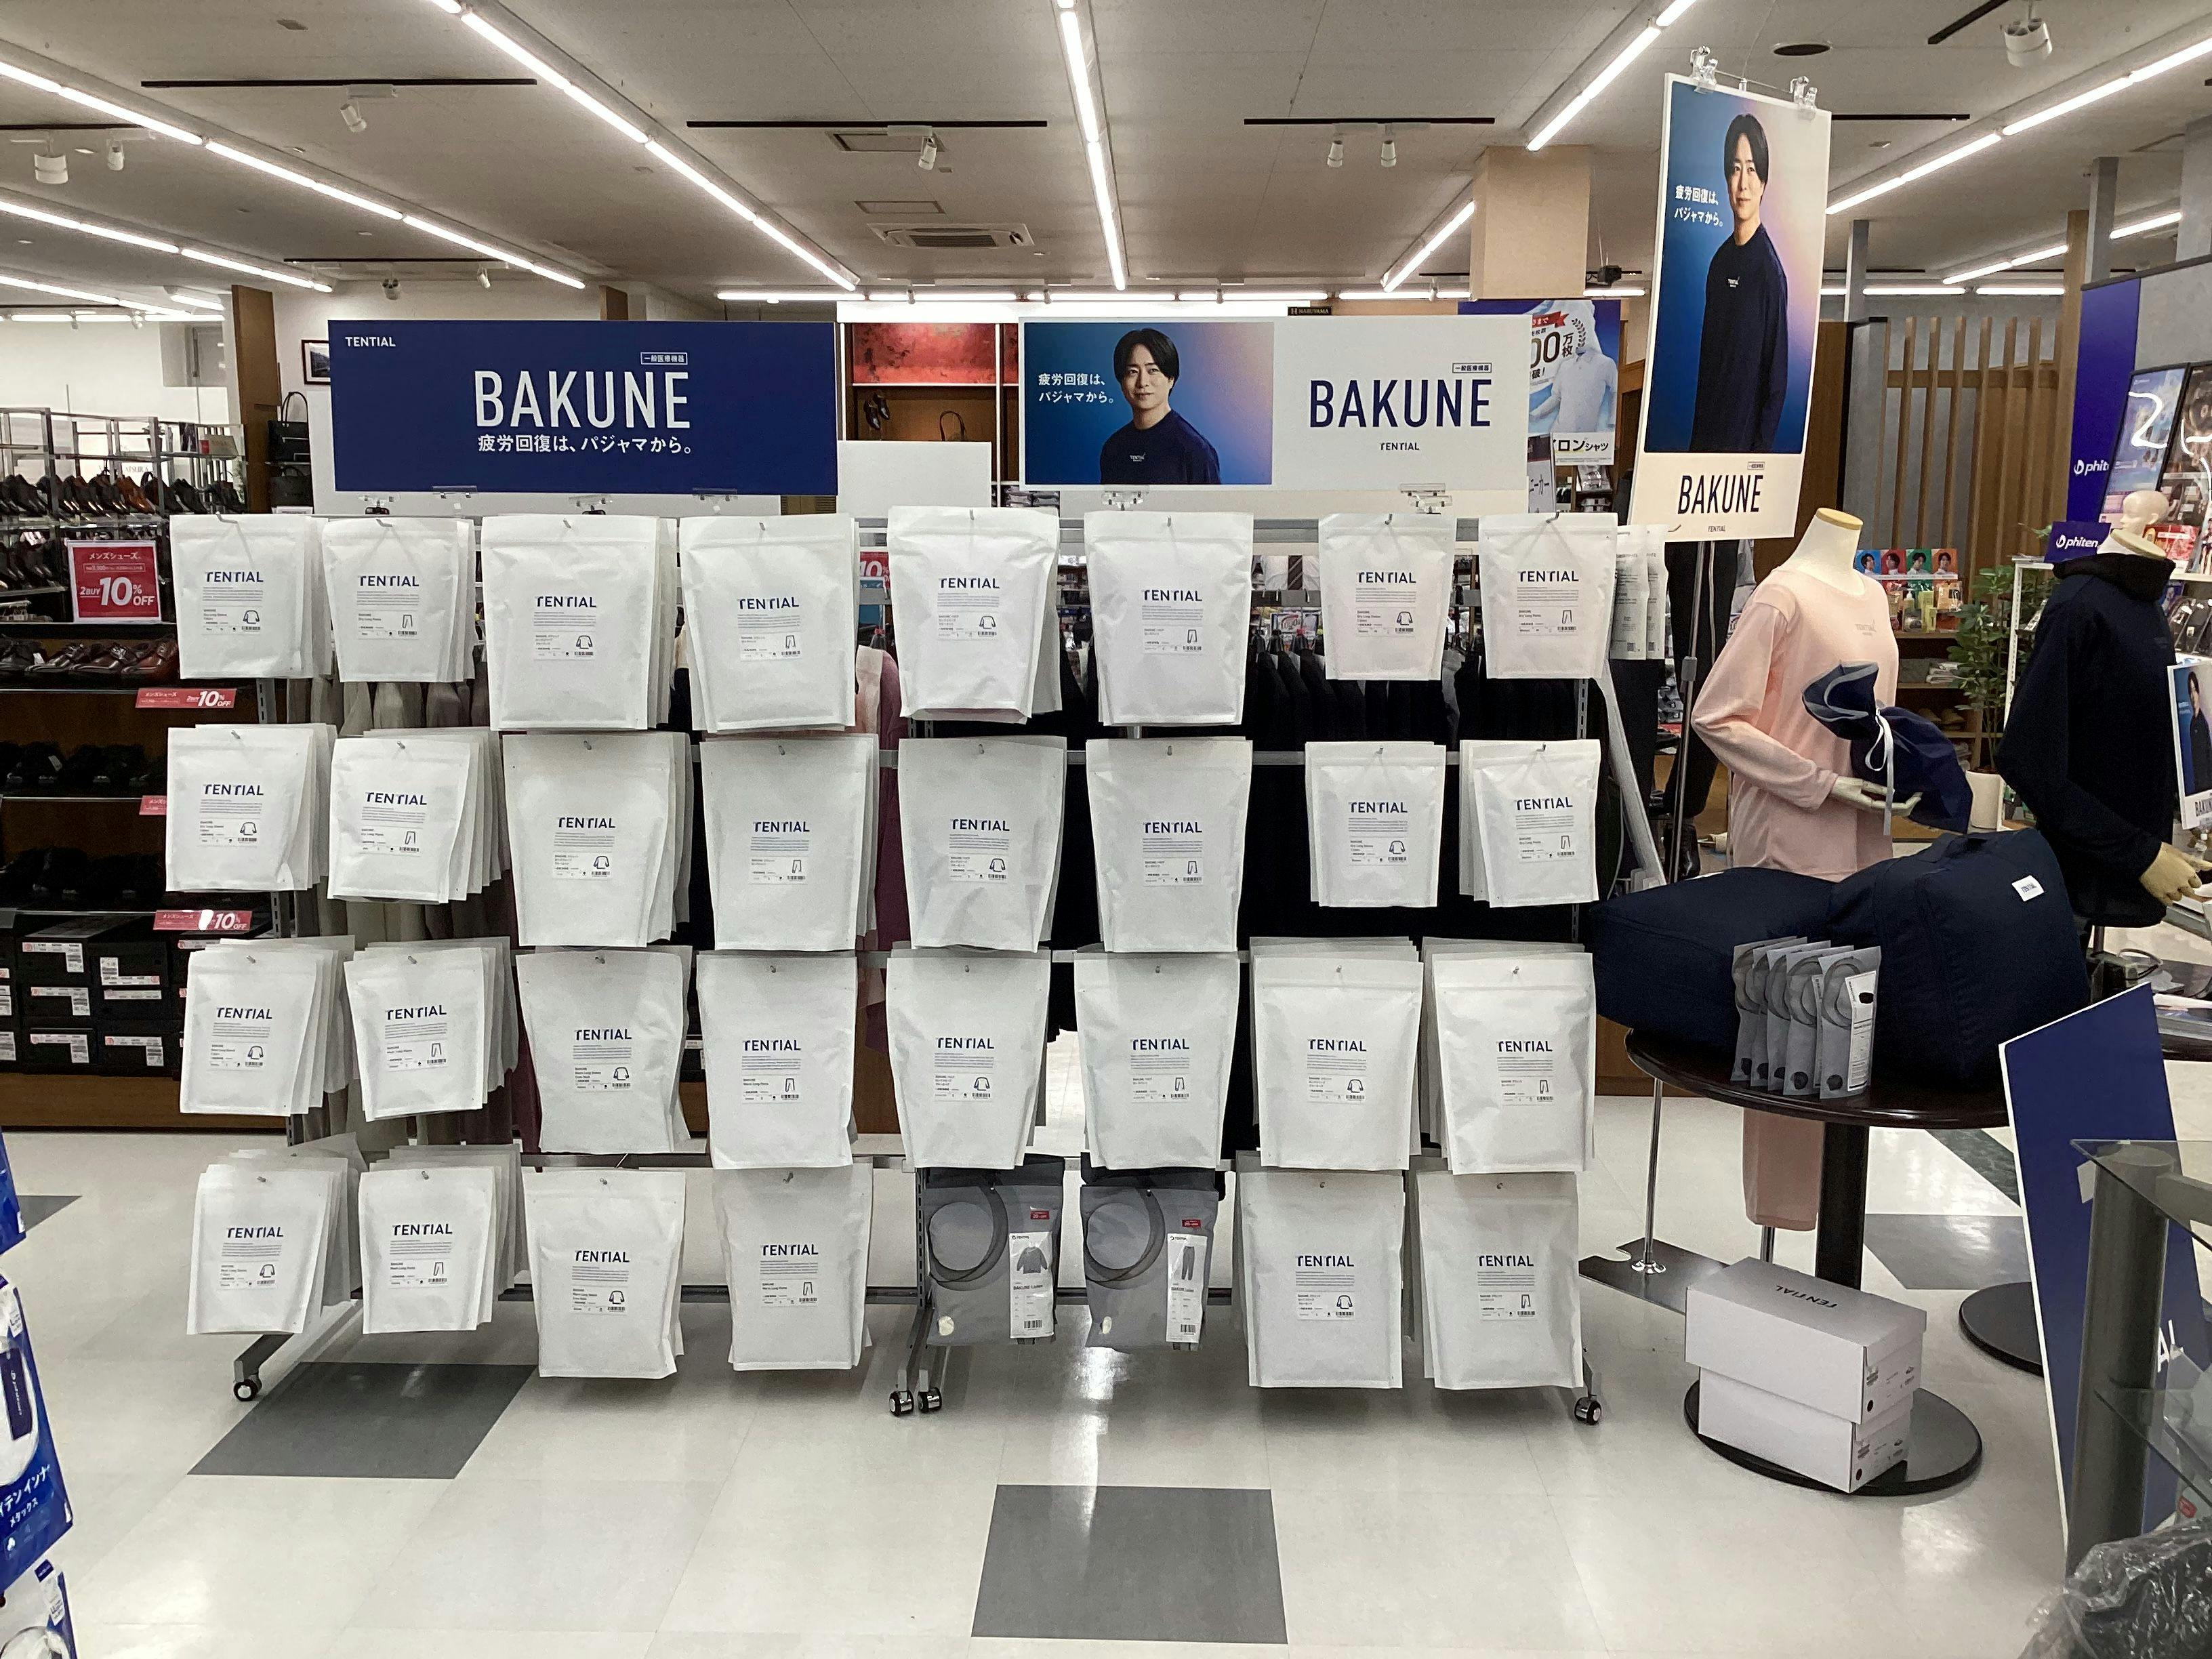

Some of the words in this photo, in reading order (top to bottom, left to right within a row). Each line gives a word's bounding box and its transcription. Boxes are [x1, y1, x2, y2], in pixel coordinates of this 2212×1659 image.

[1675, 184, 1719, 205] 疲労回復は、
[1674, 207, 1723, 227] パジャマから。
[345, 336, 396, 347] TENTIAL
[1038, 373, 1105, 386] 疲労回復は、
[475, 371, 691, 428] BAKUNE
[1038, 390, 1114, 404] パジャマから。
[1310, 379, 1492, 428] BAKUNE
[478, 434, 691, 454] 疲労回復は、パジャマから。
[1380, 442, 1420, 451] TENTIAL
[2084, 459, 2110, 476] phit
[1677, 474, 1763, 514] BAKUNE
[2064, 536, 2099, 550] phiten
[205, 571, 264, 583] TENTIAL
[359, 575, 419, 588] TENTIAL
[1357, 571, 1417, 584] TENTIAL
[1516, 570, 1580, 582] TENTIAL
[939, 577, 1000, 590] TENTIAL
[133, 595, 155, 606] OFF
[1141, 589, 1203, 602] TENTIAL
[535, 596, 597, 609] TENTIAL
[737, 596, 800, 610] TENTIAL
[203, 783, 264, 796] TENTIAL
[364, 792, 428, 806] TENTIAL
[1513, 796, 1574, 811] TENTIAL
[1347, 802, 1408, 813] TENTIAL
[556, 817, 616, 829] TENTIAL
[753, 821, 811, 833] TENTIAL
[950, 819, 1010, 832] TENTIAL
[1141, 821, 1203, 834] TENTIAL
[215, 1007, 273, 1020] TENTIAL
[385, 1004, 447, 1021] TENTIAL
[573, 1028, 632, 1041] TENTIAL
[741, 1039, 802, 1052] TENTIAL
[935, 1037, 995, 1050] TENTIAL
[1131, 1038, 1190, 1050] TENTIAL
[1305, 1038, 1367, 1052] TENTIAL
[1496, 1040, 1553, 1052] TENTIAL
[226, 1227, 284, 1239] TENTIAL
[391, 1223, 453, 1236] TENTIAL
[573, 1250, 630, 1263] TENTIAL
[761, 1244, 819, 1256] TENTIAL
[1296, 1255, 1355, 1267] TENTIAL
[1476, 1255, 1534, 1267] TENTIAL
[1776, 1285, 1838, 1308] TENTIAL
